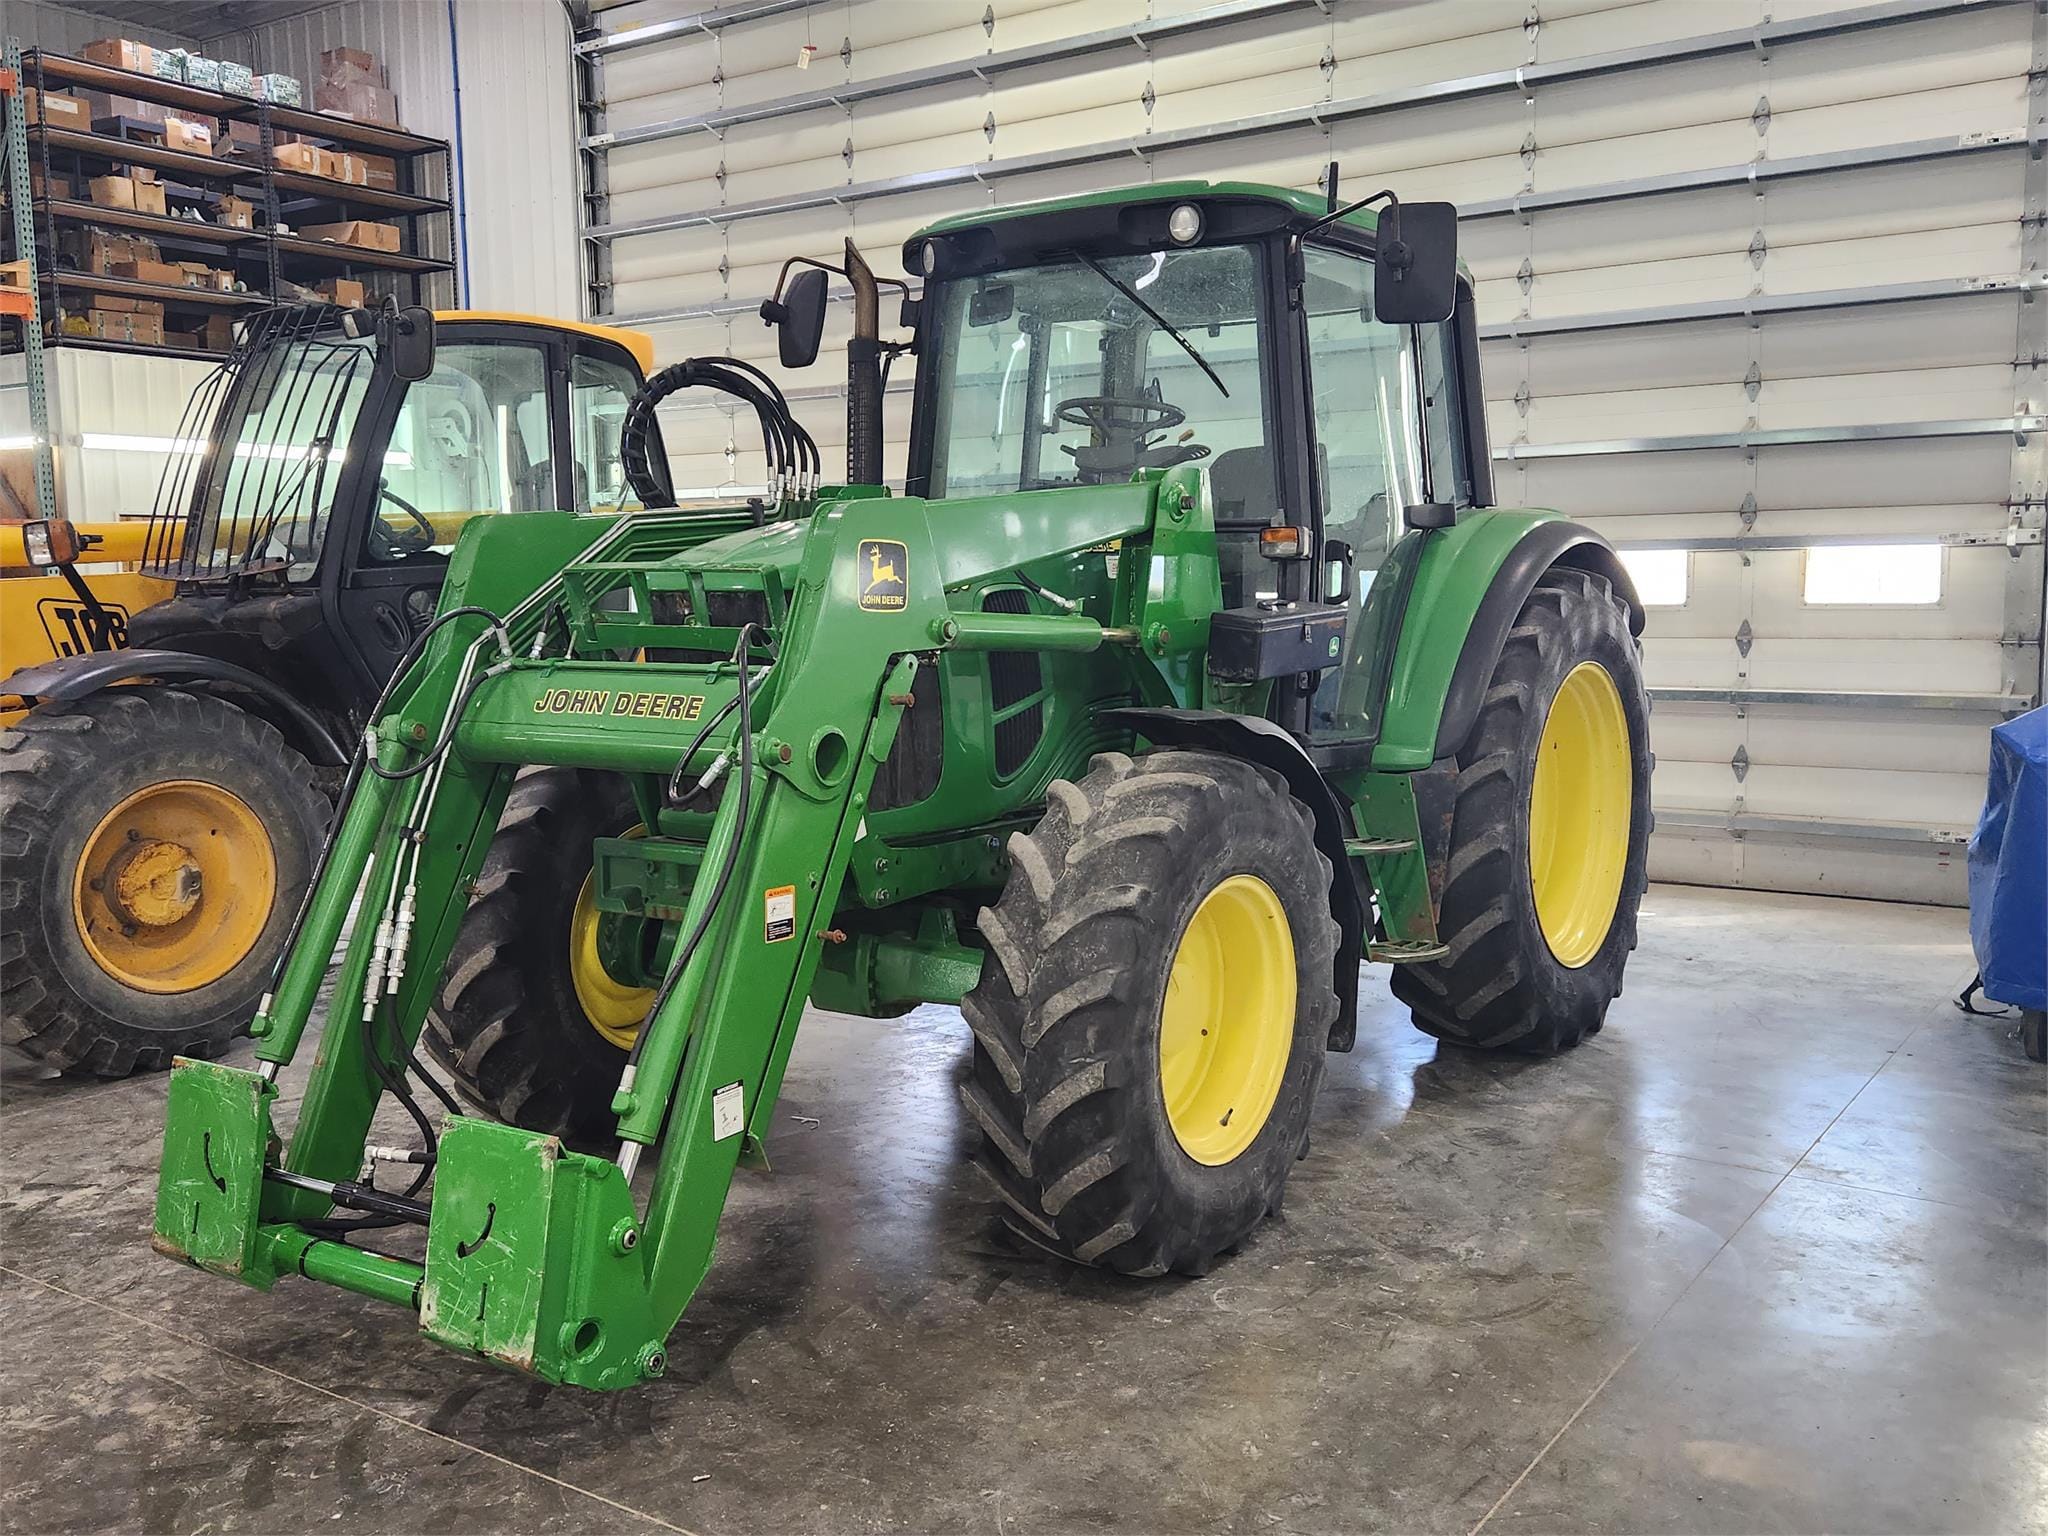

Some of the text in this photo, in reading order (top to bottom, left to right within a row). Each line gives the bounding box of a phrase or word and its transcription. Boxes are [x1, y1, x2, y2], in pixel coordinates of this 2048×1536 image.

[862, 594, 904, 605] JOHN DEERE
[534, 688, 706, 721] JOHN DEERE
